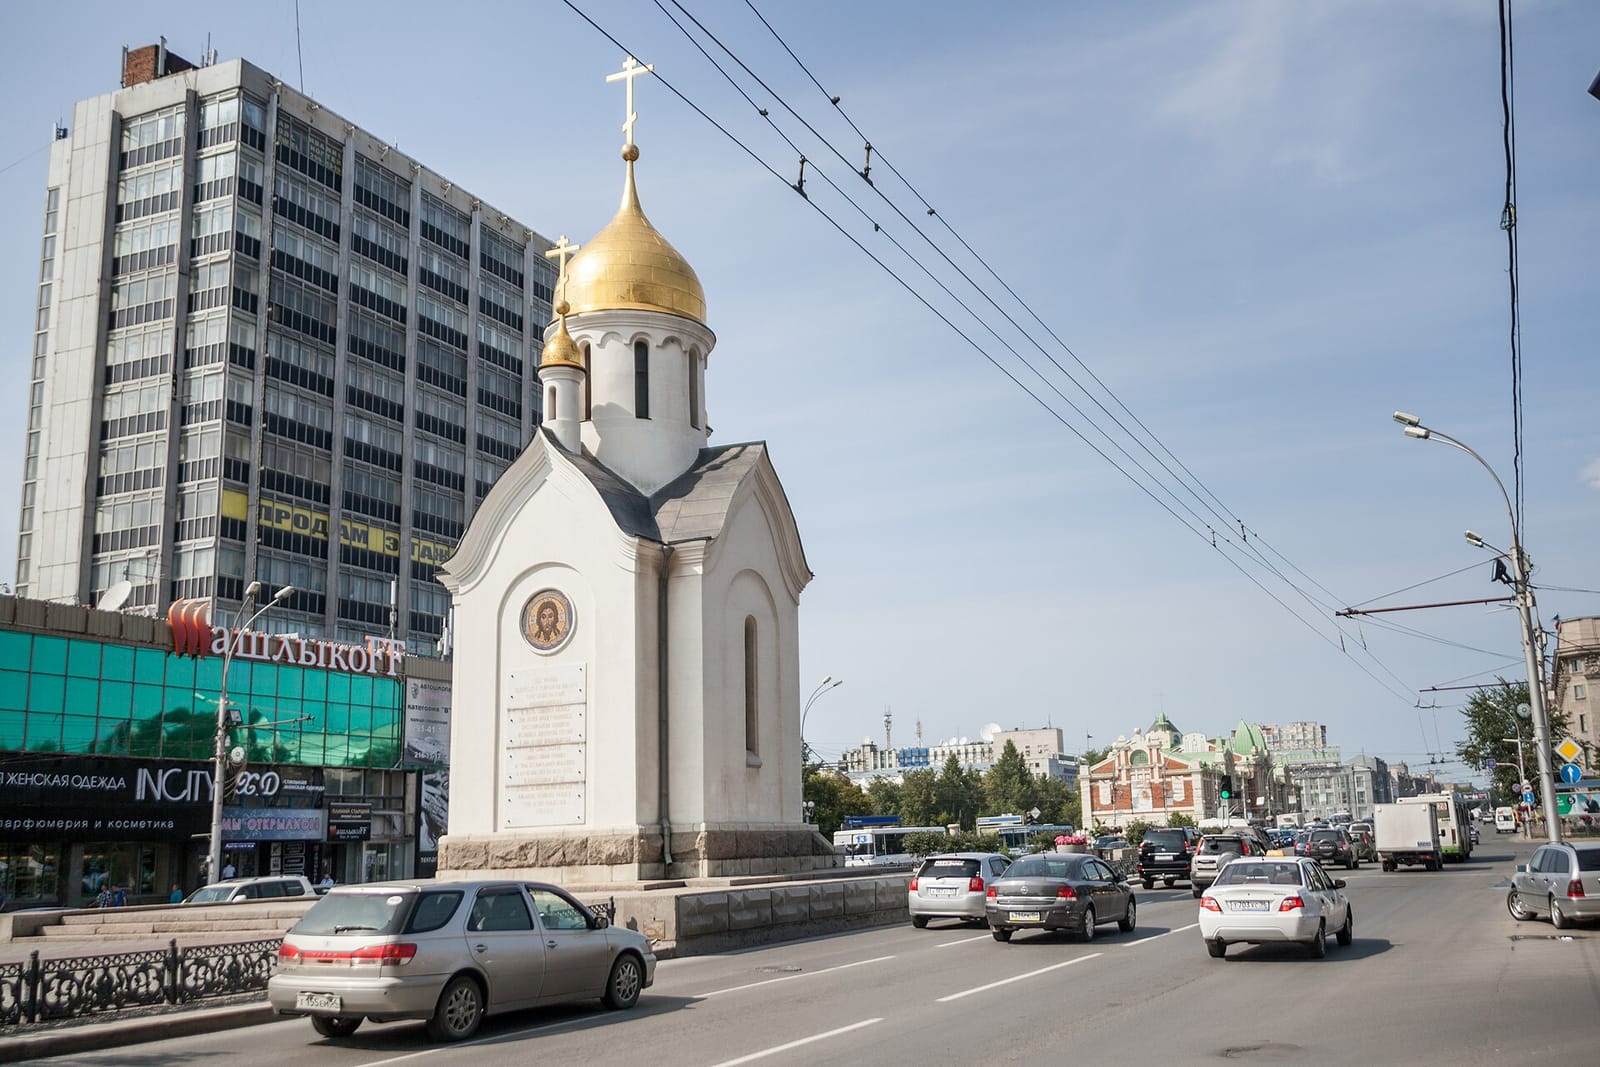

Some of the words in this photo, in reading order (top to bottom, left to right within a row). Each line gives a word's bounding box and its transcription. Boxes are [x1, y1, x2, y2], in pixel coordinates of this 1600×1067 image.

[260, 503, 368, 543] ПРОДАМ
[385, 536, 450, 562] ЭТАЖ
[6, 772, 69, 787] ЖЕНСКАЯ
[71, 774, 126, 790] ОДЕЖДА
[136, 768, 216, 801] INCITY
[95, 820, 102, 828] и
[107, 819, 175, 829] косметика
